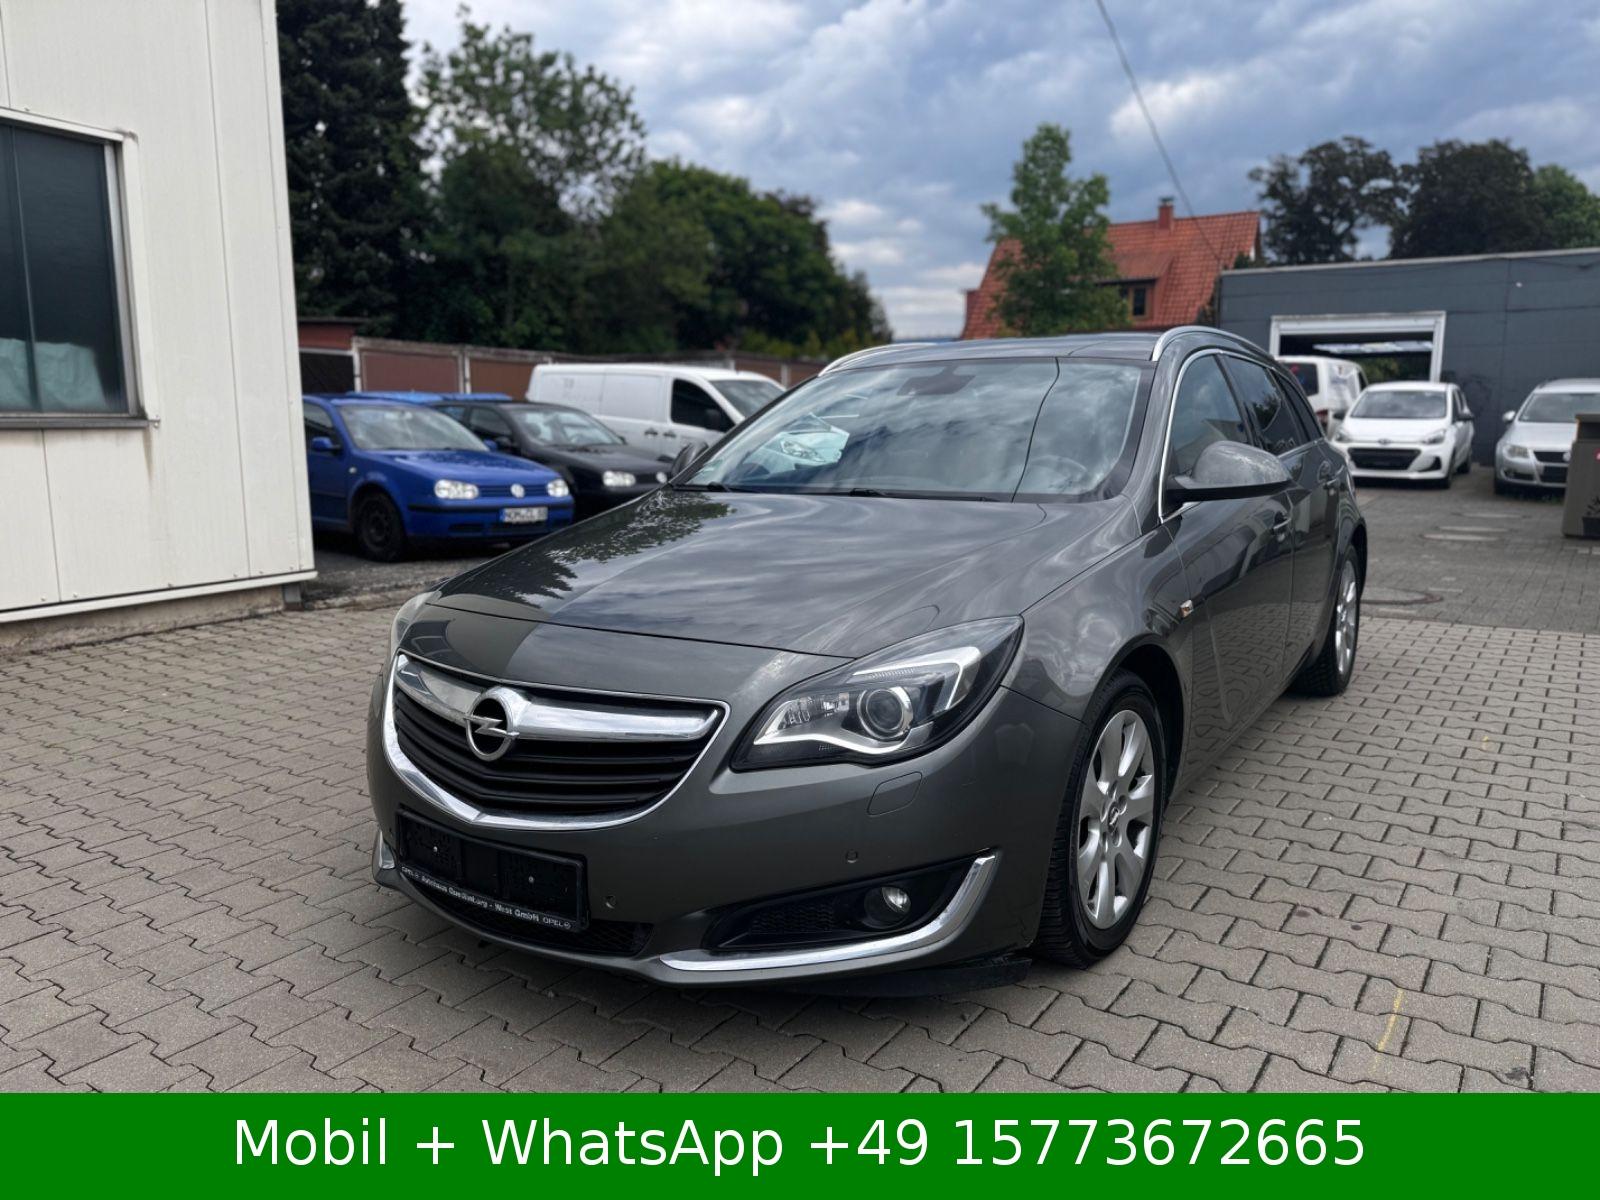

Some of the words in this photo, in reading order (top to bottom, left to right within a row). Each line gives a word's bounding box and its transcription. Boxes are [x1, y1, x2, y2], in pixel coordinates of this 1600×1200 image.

[495, 902, 513, 915] West
[514, 908, 540, 922] GmbH
[542, 917, 563, 928] OPEL
